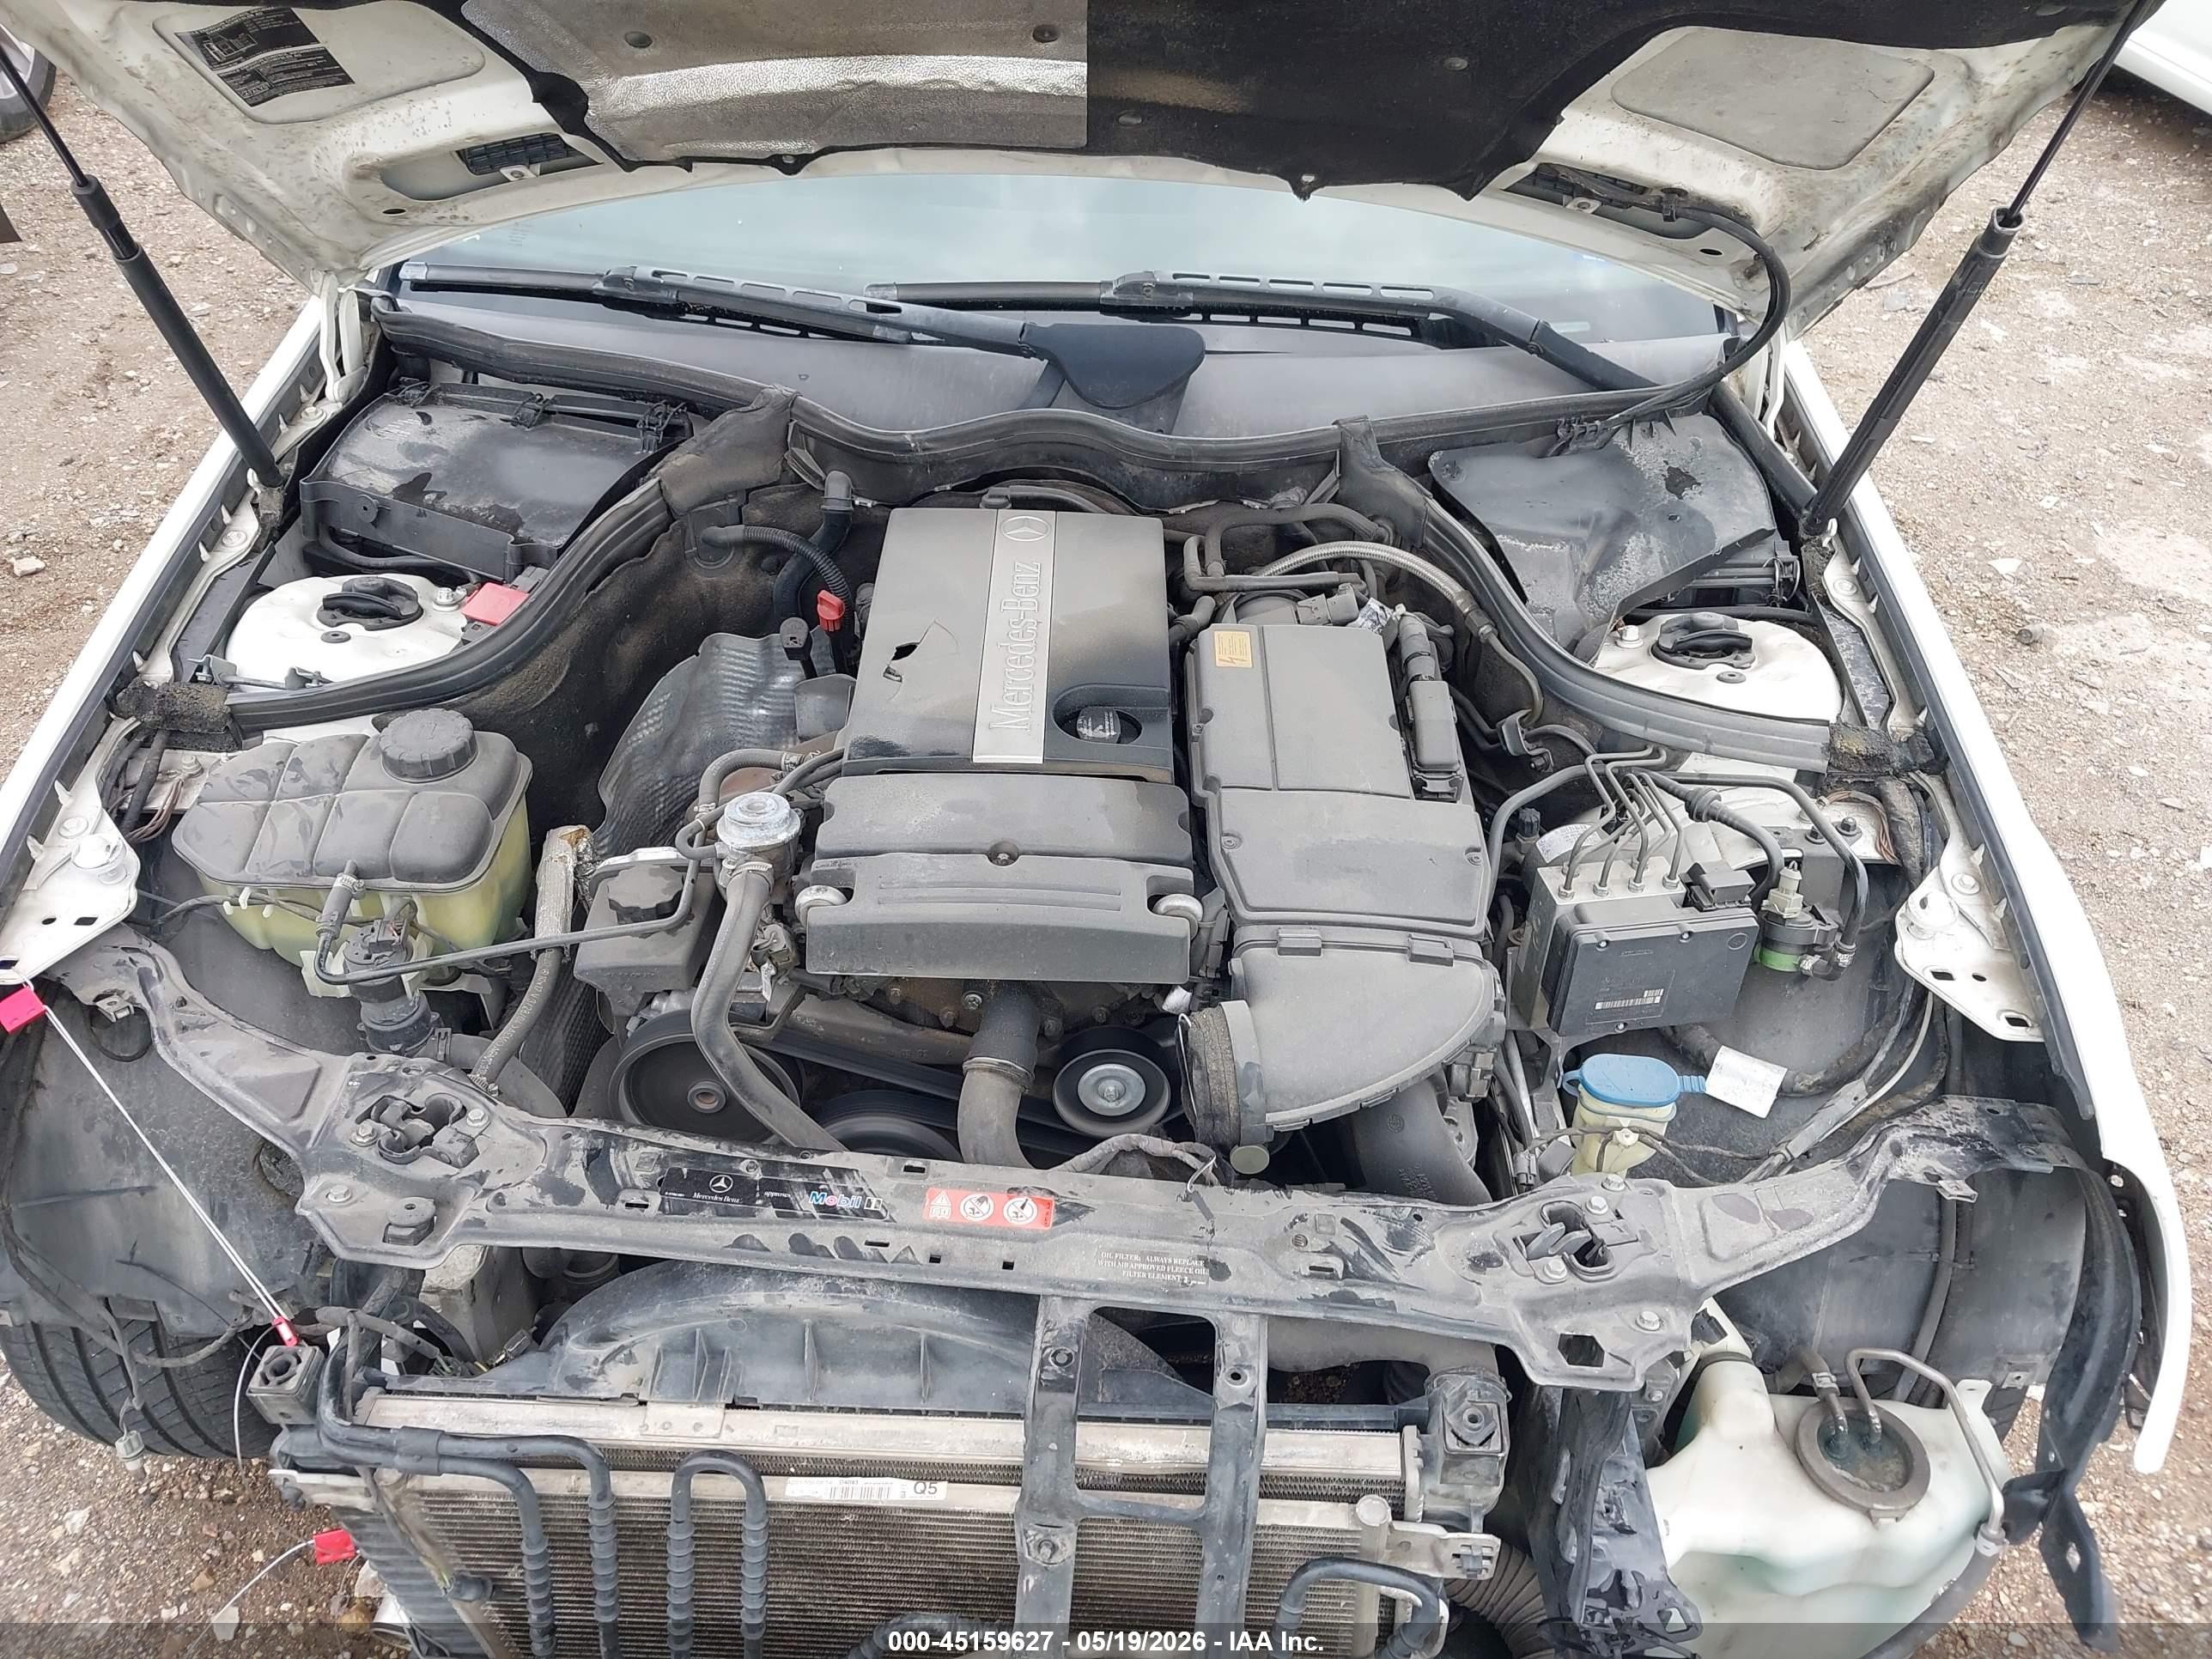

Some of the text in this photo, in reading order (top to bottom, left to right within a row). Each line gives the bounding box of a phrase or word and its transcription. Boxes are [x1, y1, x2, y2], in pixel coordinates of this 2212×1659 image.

[989, 561, 1041, 732] Mercedes-Benz
[810, 1192, 862, 1209] Mobil
[1097, 1258, 1116, 1267] WITH
[1129, 1262, 1166, 1272] APPROVED
[1167, 1265, 1194, 1274] FLEECE
[1146, 1255, 1172, 1264] ALWAYS
[1173, 1257, 1206, 1267] REPLACE
[1122, 1270, 1182, 1281] FILTER ELEMENT
[914, 1481, 938, 1495] Q5
